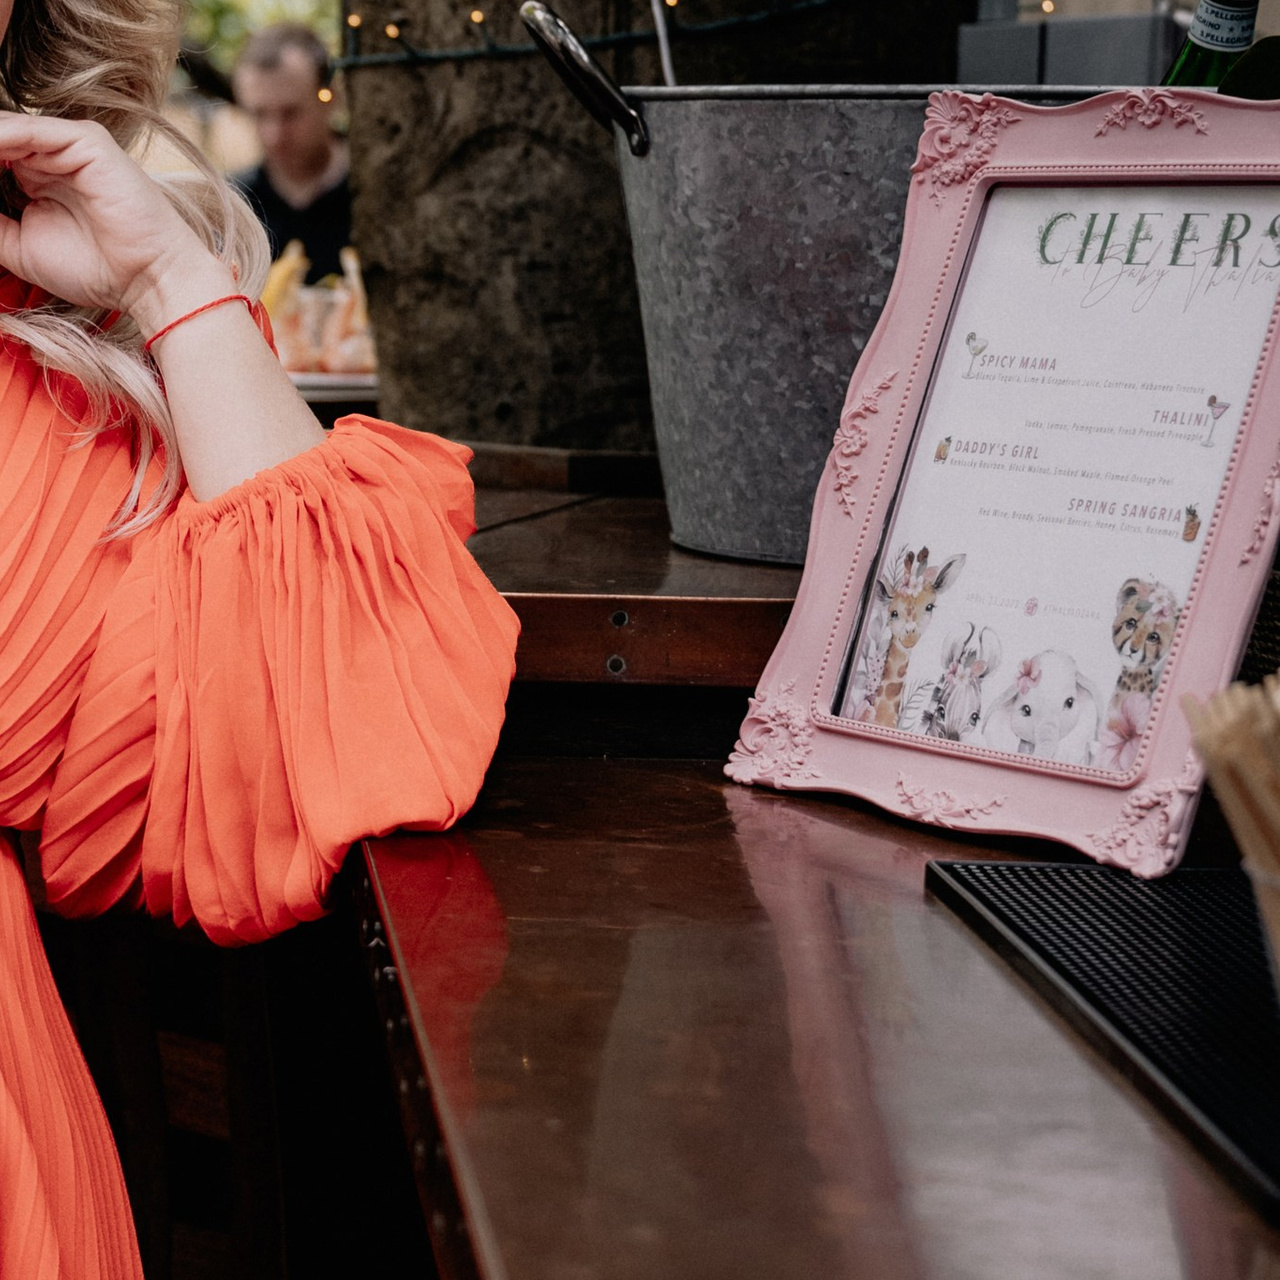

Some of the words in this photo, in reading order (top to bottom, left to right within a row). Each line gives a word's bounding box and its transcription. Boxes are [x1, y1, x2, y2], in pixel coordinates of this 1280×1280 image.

[1080, 240, 1169, 314] Baby
[979, 354, 1016, 368] SPICY
[1019, 356, 1057, 371] MAMA
[1024, 375, 1039, 384] Lime
[1152, 410, 1210, 427] THALINI
[1119, 426, 1137, 436] Fresh
[1139, 428, 1165, 438] Pressed
[954, 440, 1008, 457] DADDY'S
[1011, 445, 1039, 460] GIRL
[1008, 463, 1025, 472] Black
[1053, 467, 1079, 477] Smoked
[1131, 474, 1156, 486] Orange
[978, 507, 991, 516] Red
[1067, 498, 1117, 516] SPRING
[1121, 503, 1181, 523] SANGRIA
